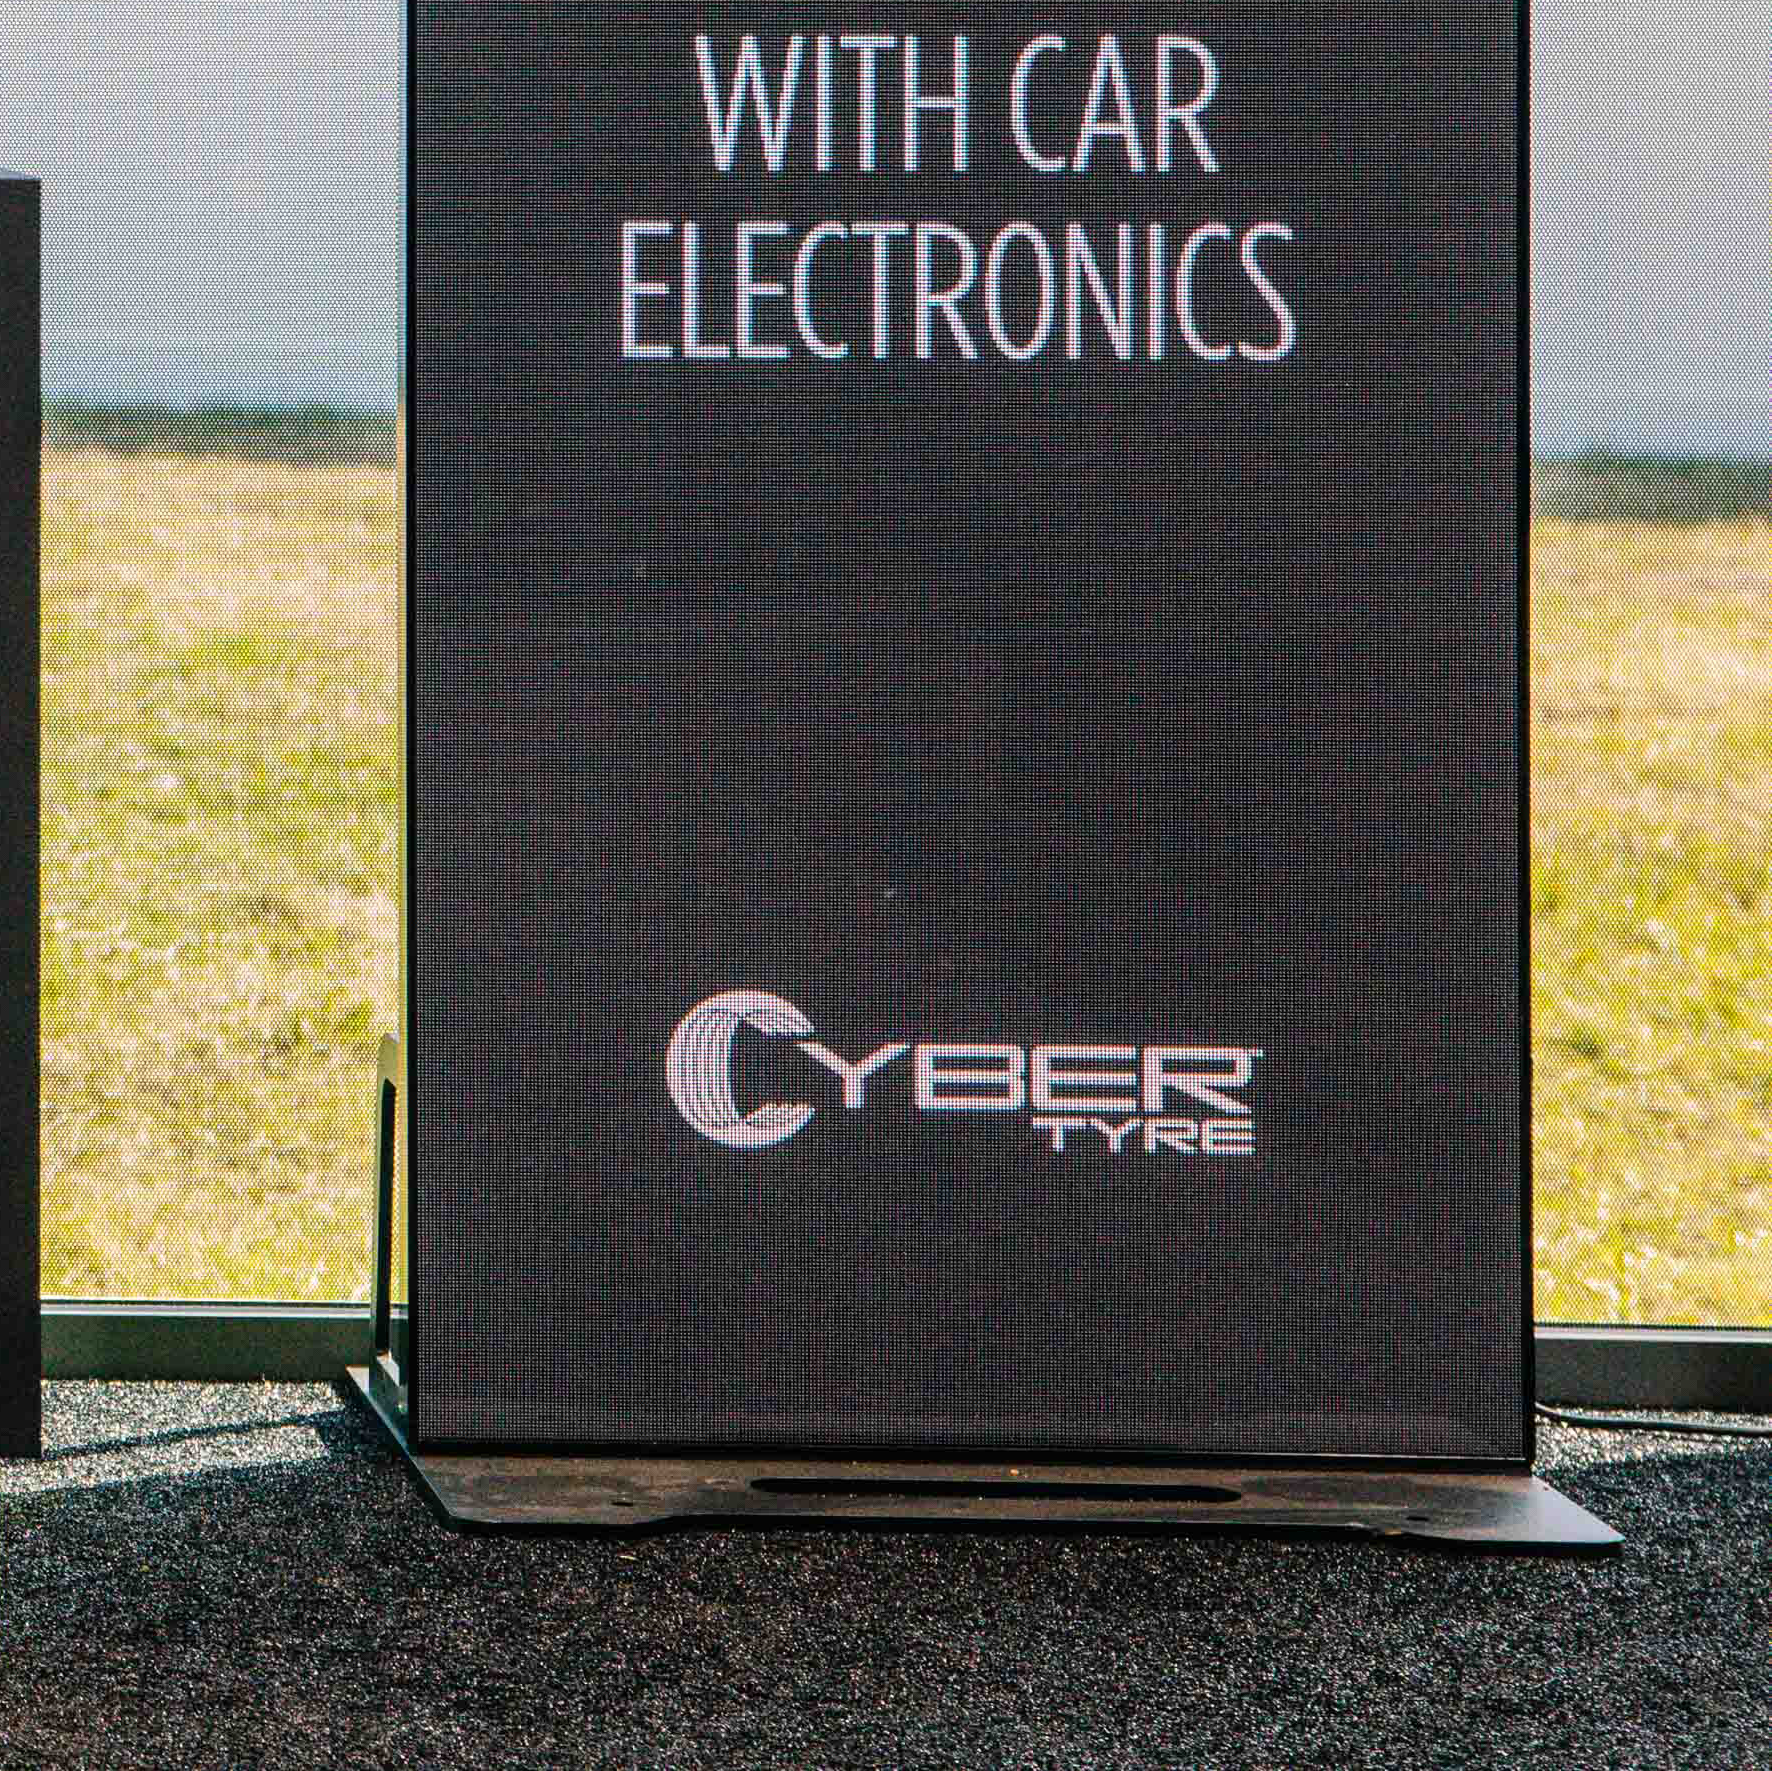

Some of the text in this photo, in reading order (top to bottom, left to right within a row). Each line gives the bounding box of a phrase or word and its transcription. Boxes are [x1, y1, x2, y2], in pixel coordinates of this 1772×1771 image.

[693, 34, 1221, 172] WITH CAR
[620, 221, 1297, 361] ELECTRONICS
[664, 988, 1254, 1148] CYBER
[1032, 1114, 1257, 1155] TYRE
